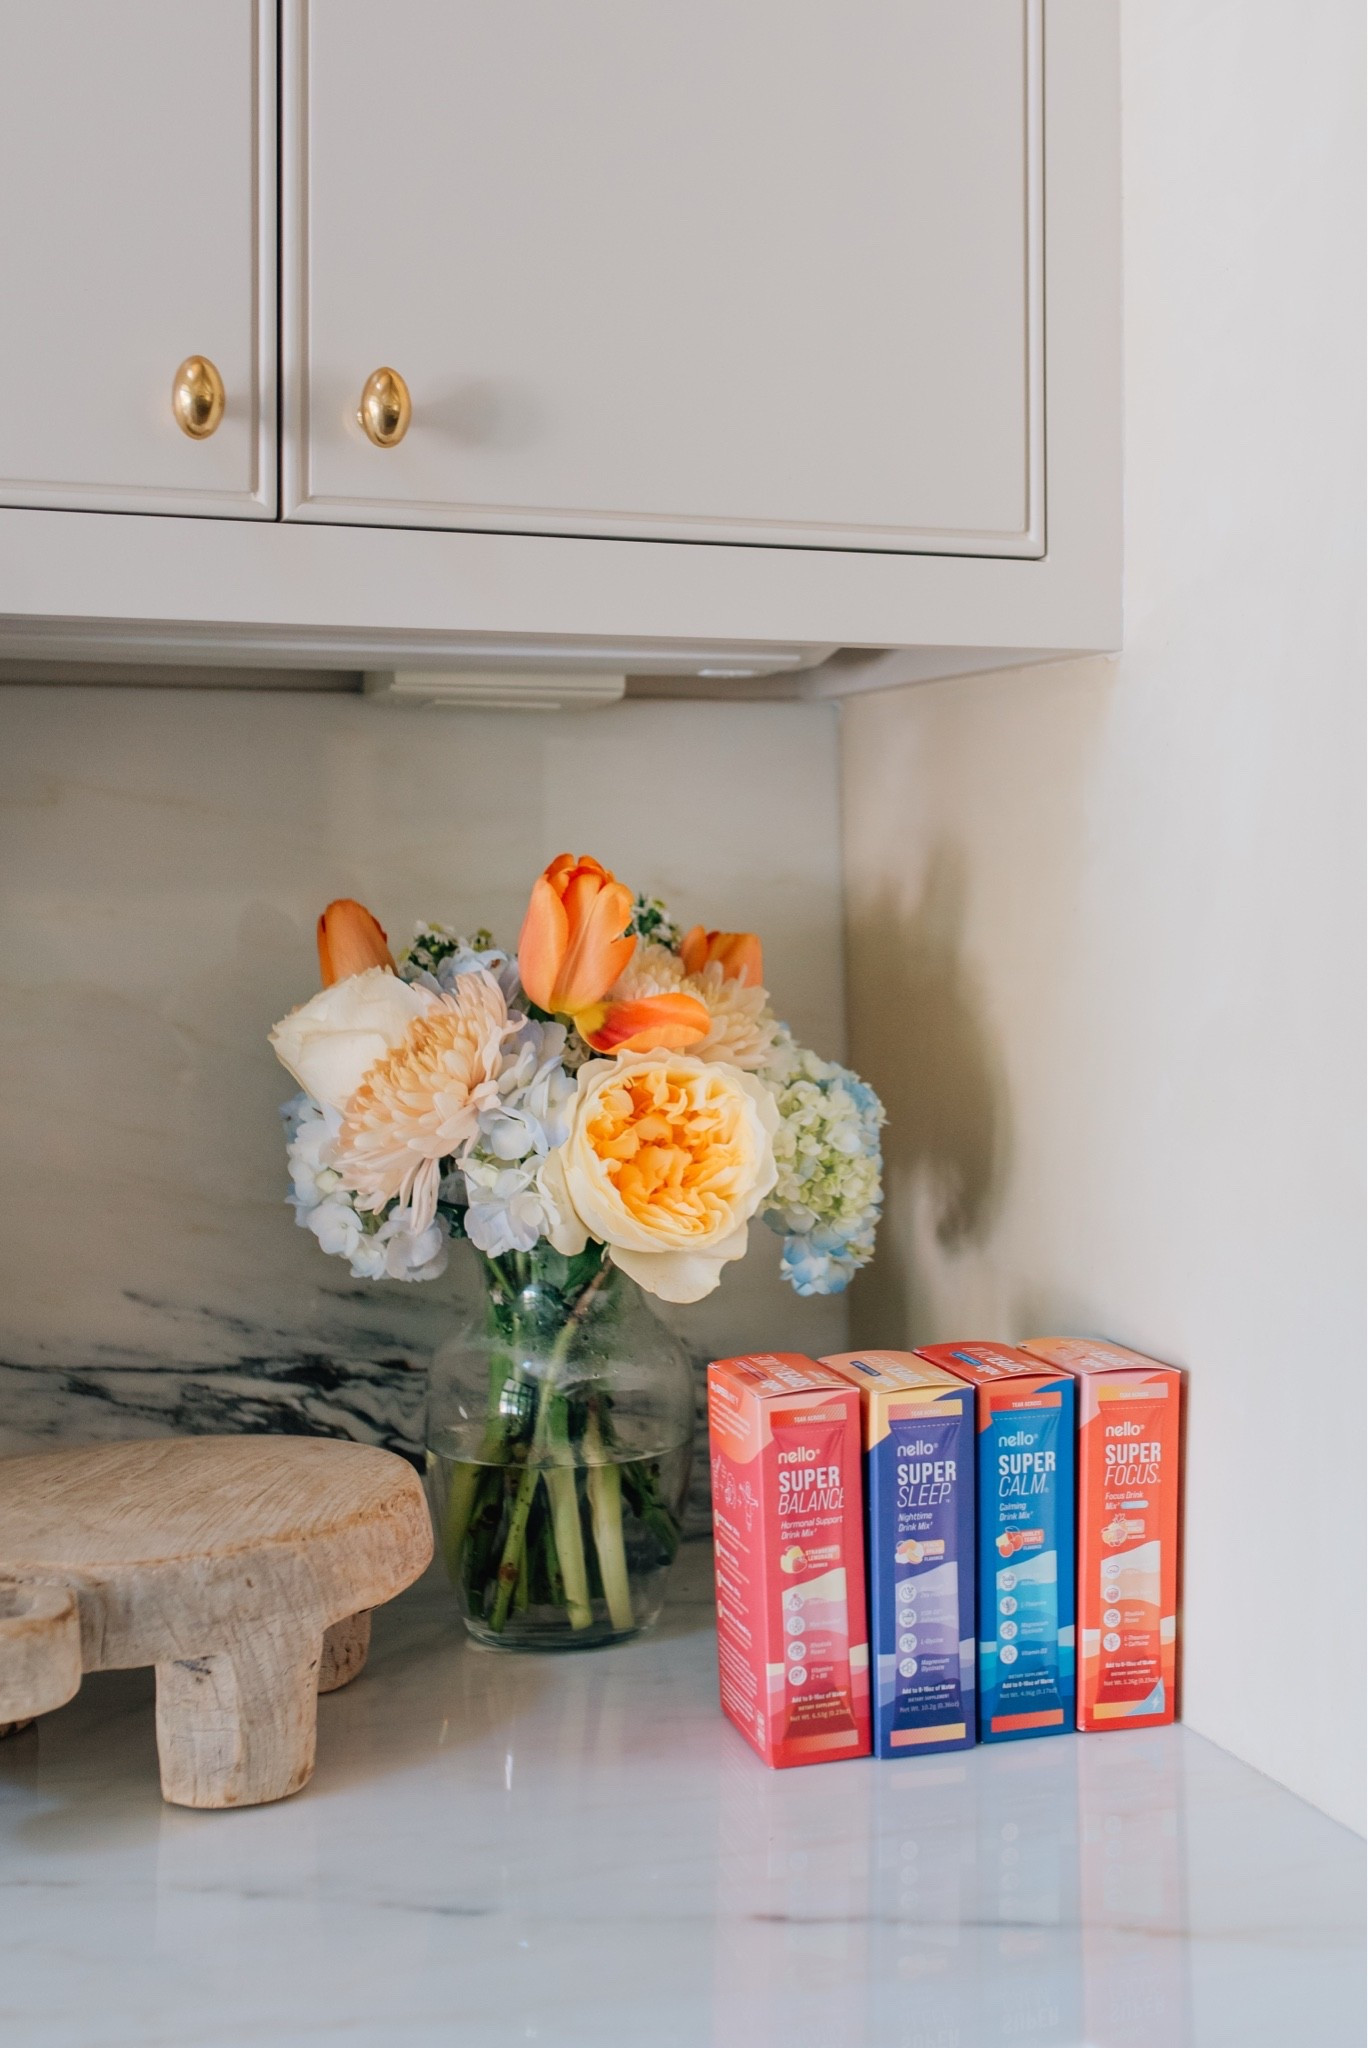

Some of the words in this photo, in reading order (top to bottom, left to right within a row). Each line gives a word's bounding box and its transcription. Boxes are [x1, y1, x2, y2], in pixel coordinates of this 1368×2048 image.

[1105, 1421, 1140, 1437] nello
[998, 1431, 1034, 1447] nello
[778, 1446, 816, 1464] nello
[897, 1440, 934, 1457] nello
[1105, 1442, 1161, 1465] SUPER
[998, 1451, 1056, 1476] SUPER
[778, 1465, 840, 1493] SUPER
[897, 1460, 956, 1486] SUPER
[1104, 1463, 1159, 1486] FOCUS
[998, 1473, 1046, 1498] CALM
[778, 1488, 844, 1515] BALANCE
[897, 1482, 952, 1508] SLEEP
[1105, 1492, 1125, 1500] Focus
[1126, 1491, 1144, 1499] Drink
[999, 1502, 1027, 1512] Calming
[781, 1517, 815, 1530] Hormonal
[815, 1515, 843, 1527] Support
[898, 1512, 933, 1523] Nighttime
[999, 1512, 1017, 1521] Drink
[781, 1530, 801, 1540] Drink
[898, 1522, 917, 1532] Drink
